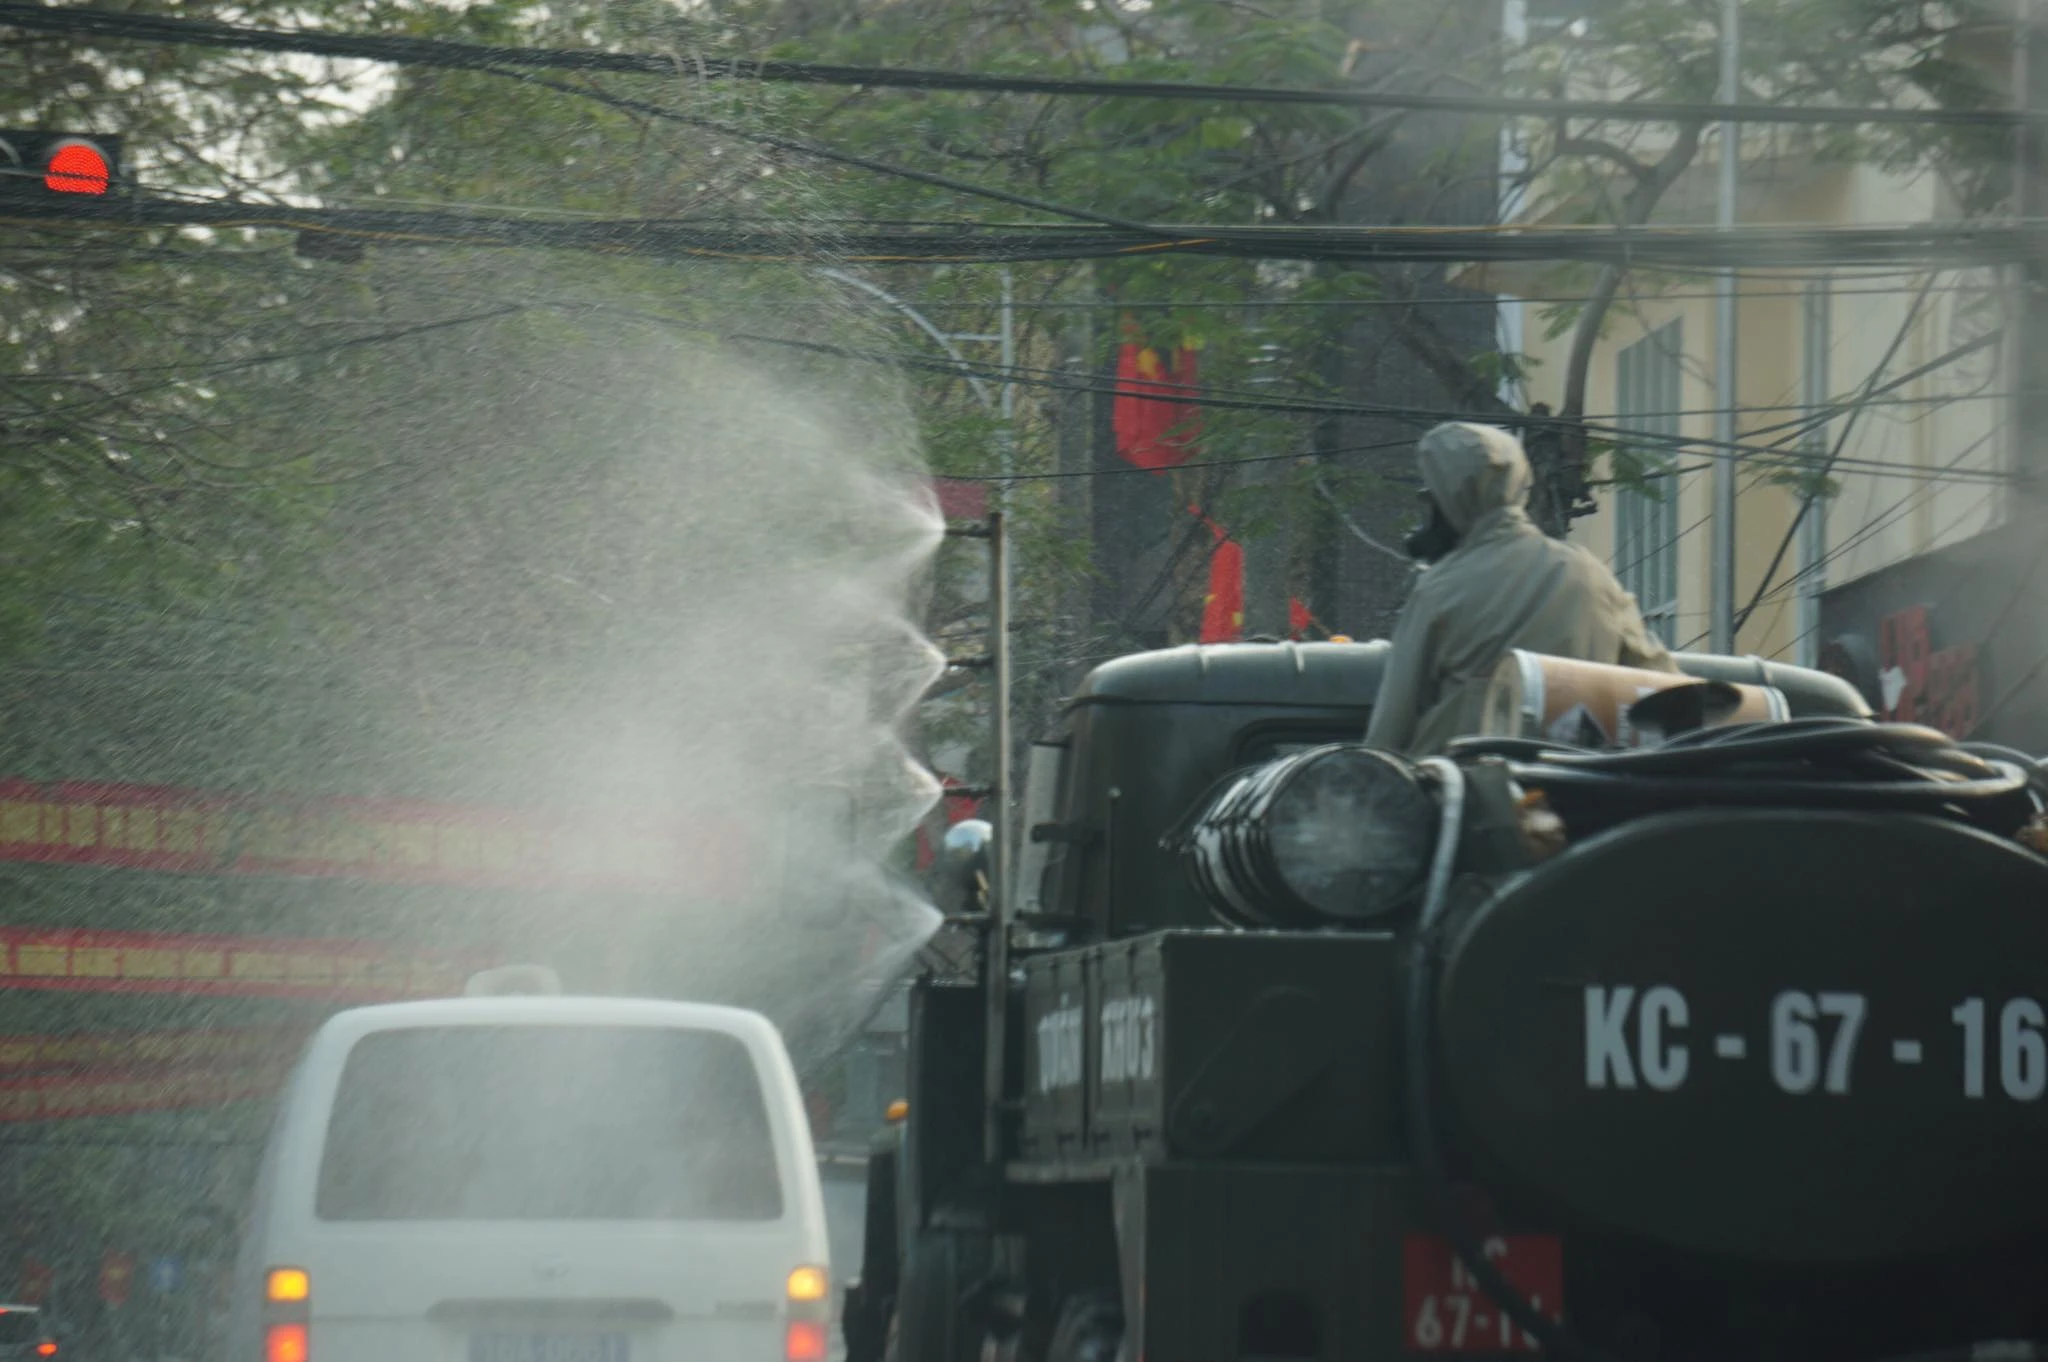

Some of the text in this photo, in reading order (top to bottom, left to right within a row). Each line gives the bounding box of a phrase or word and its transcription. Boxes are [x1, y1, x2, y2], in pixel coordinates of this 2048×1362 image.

[1584, 984, 2047, 1102] KC - 67 - 16
